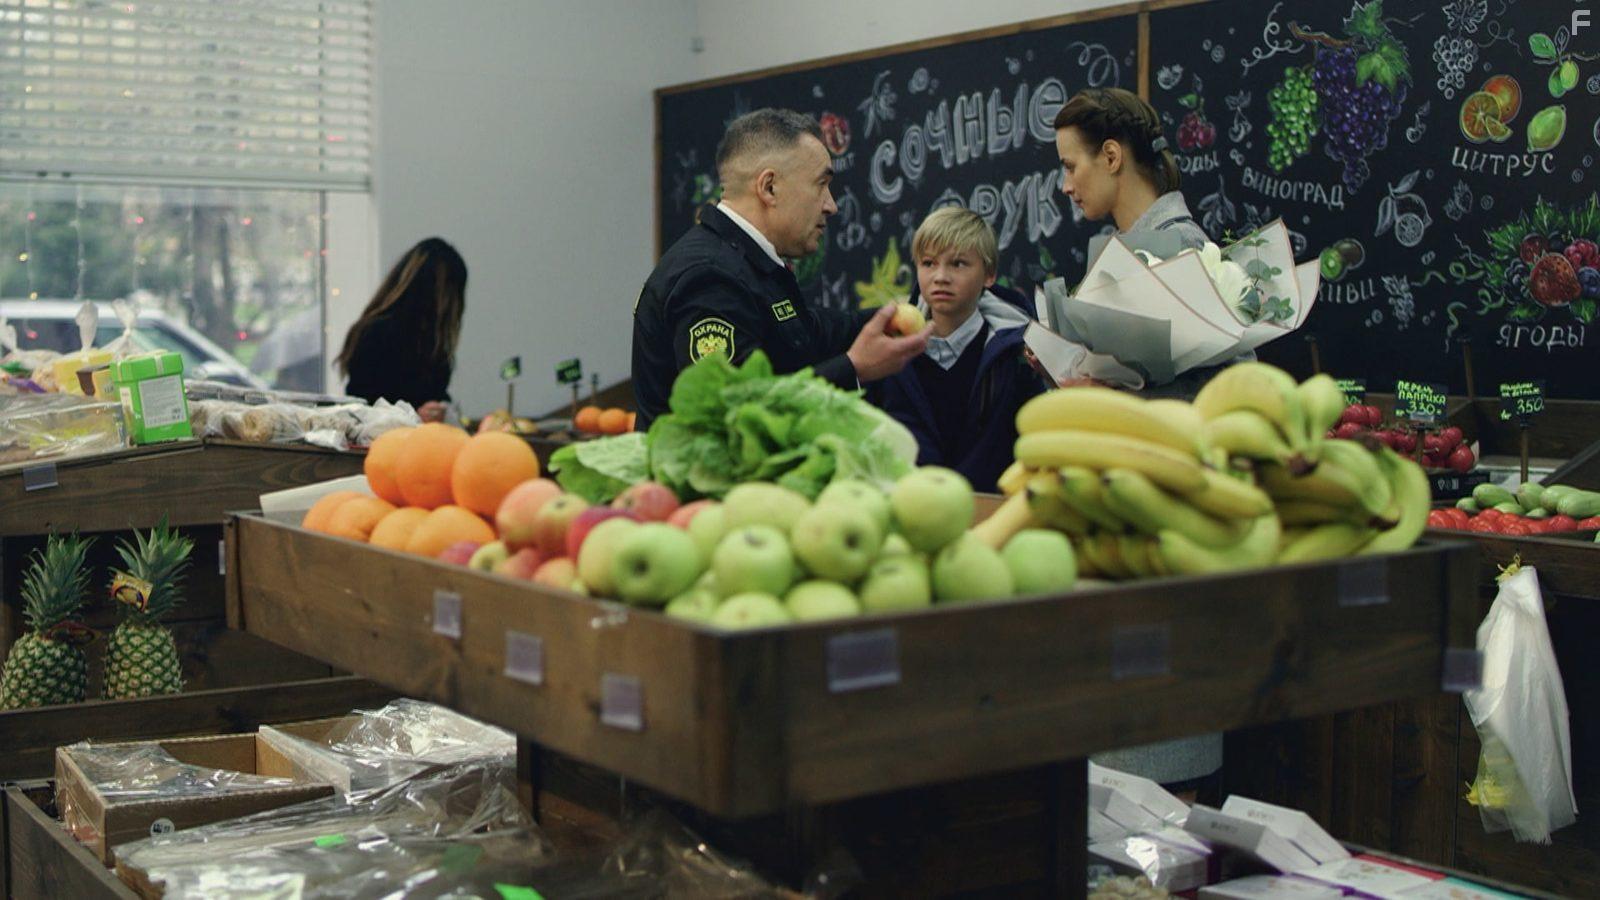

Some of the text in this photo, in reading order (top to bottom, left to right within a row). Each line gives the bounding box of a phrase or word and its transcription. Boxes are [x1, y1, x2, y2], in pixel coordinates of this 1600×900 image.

[1452, 146, 1556, 177] ЦИТРУС
[1242, 166, 1345, 210] ВИНОГРАД
[931, 168, 1084, 250] РУК
[694, 323, 730, 338] ОХРАНА
[1496, 324, 1585, 352] ЯГОДЫ
